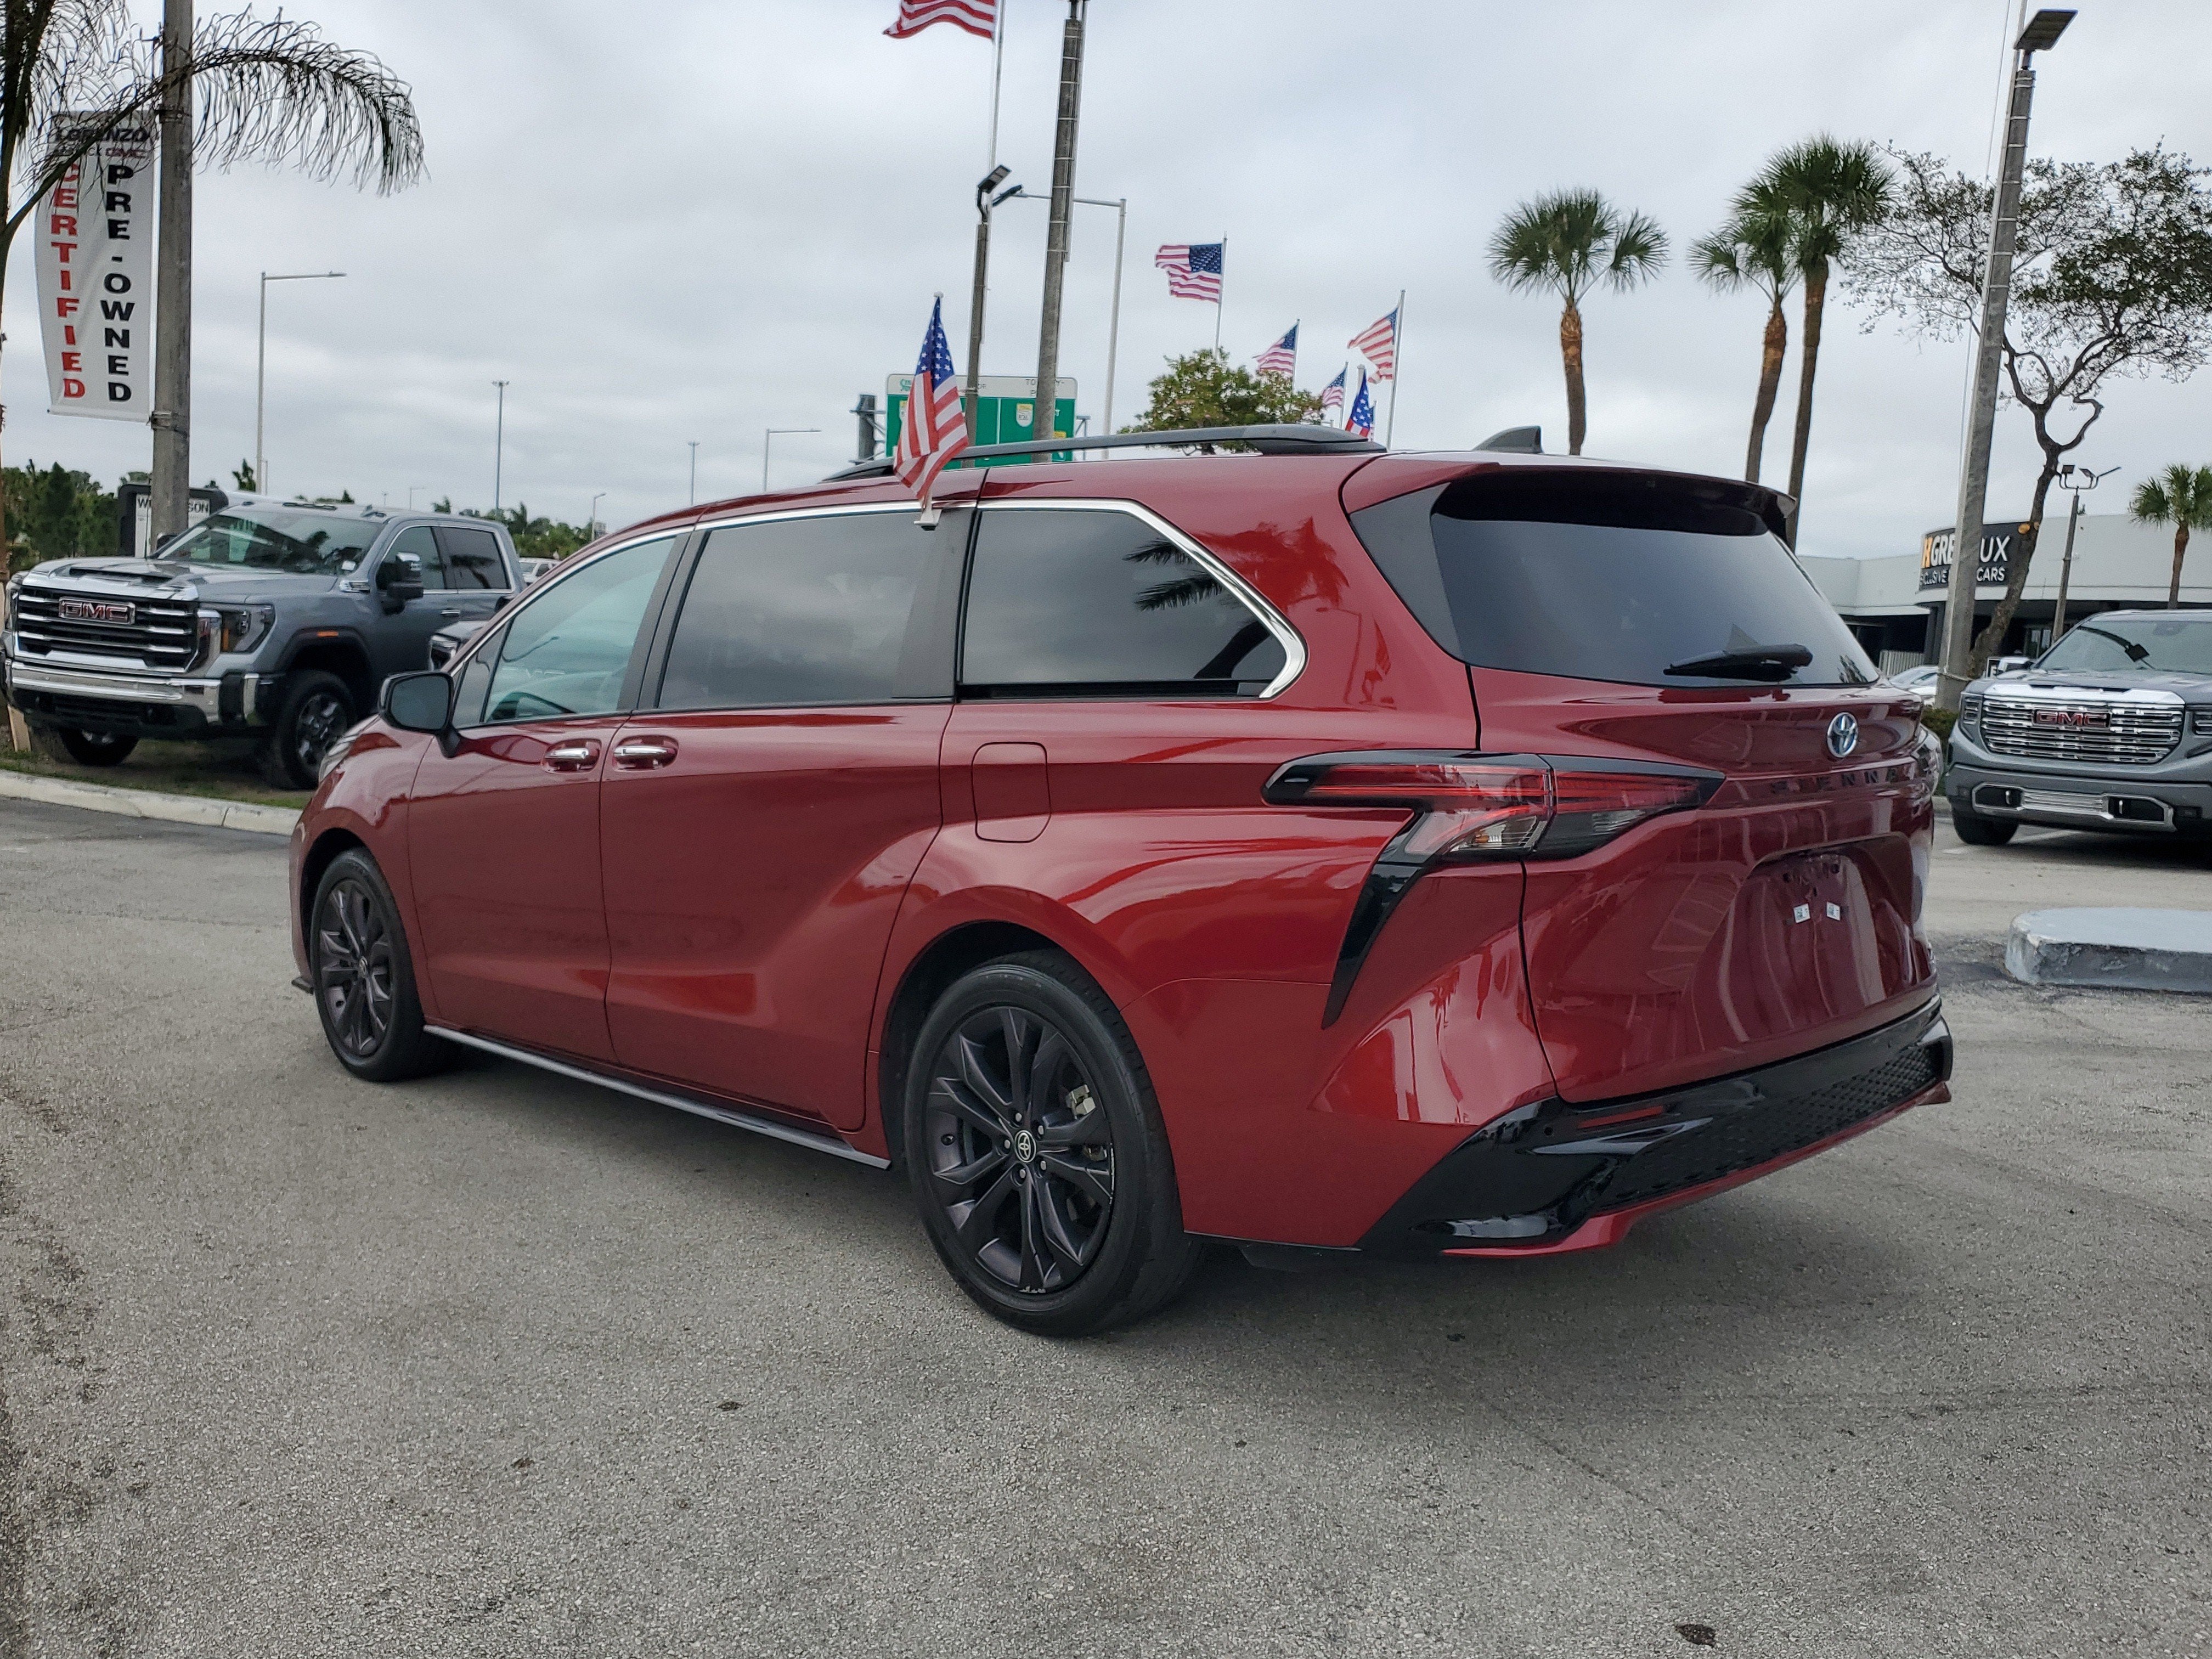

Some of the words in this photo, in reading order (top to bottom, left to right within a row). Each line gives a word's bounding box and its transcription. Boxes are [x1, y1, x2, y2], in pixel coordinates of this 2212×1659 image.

[100, 165, 135, 402] PRE-OWNED
[1976, 567, 2005, 582] CARS
[62, 601, 128, 623] GMC
[2036, 710, 2107, 728] GMC
